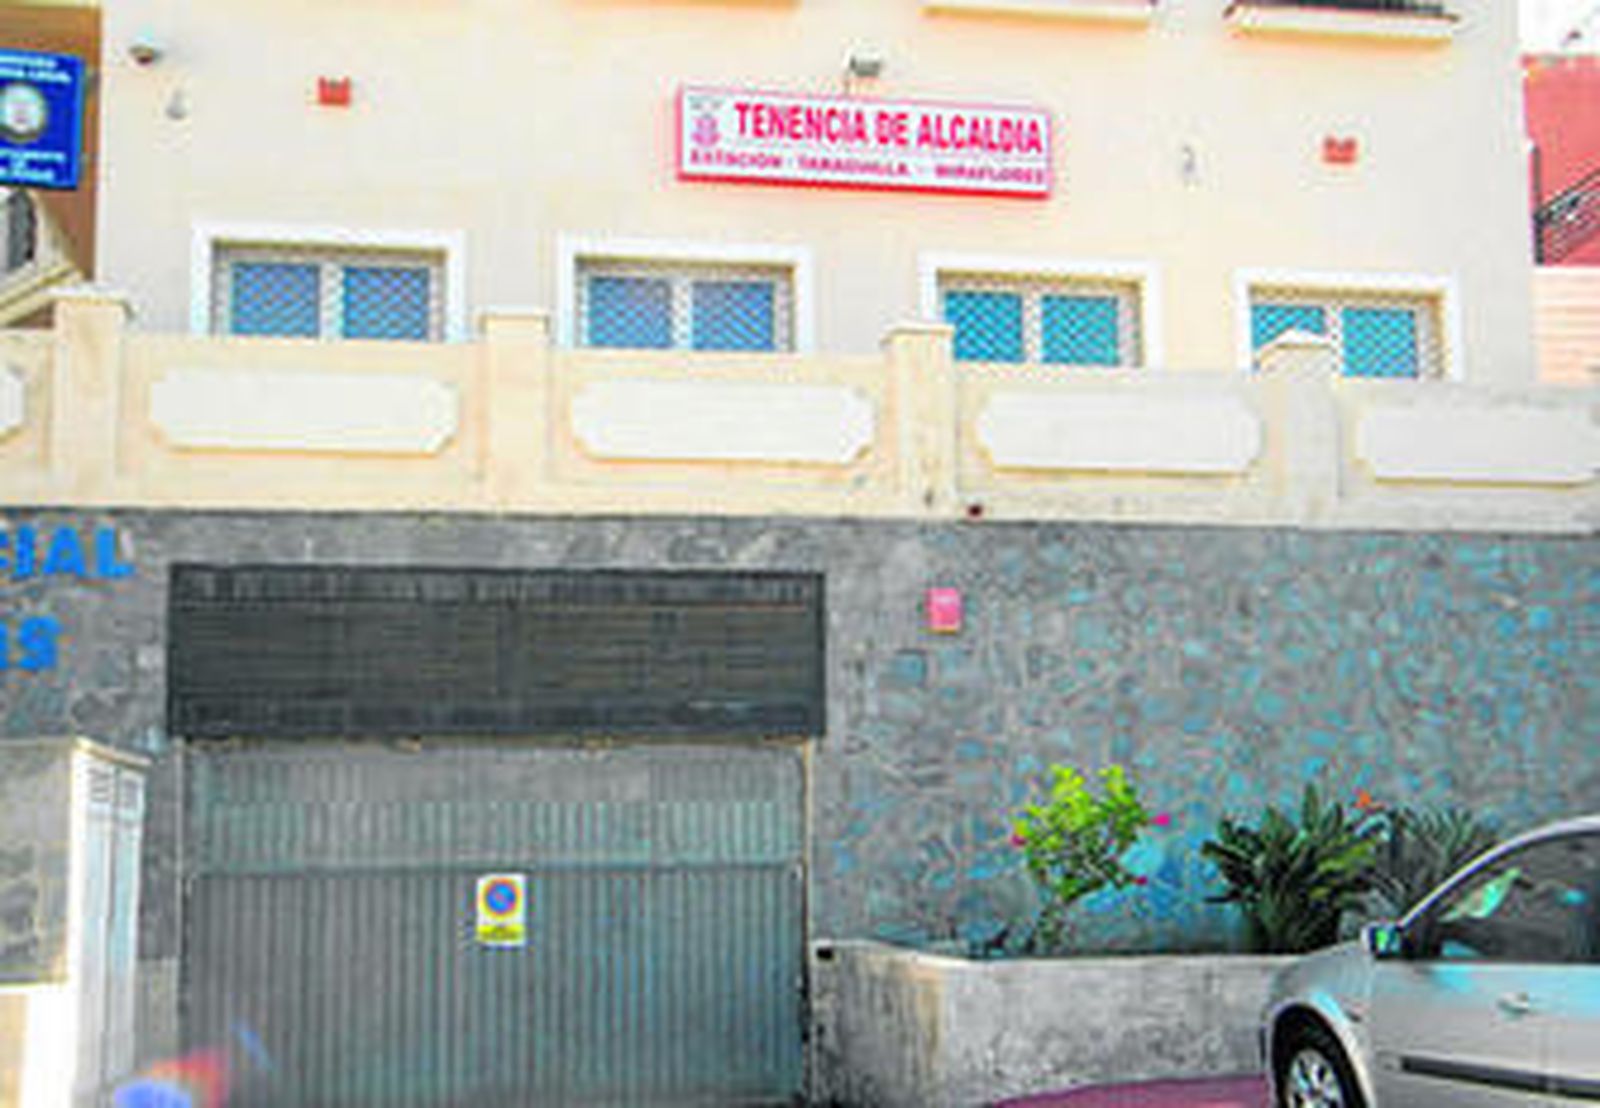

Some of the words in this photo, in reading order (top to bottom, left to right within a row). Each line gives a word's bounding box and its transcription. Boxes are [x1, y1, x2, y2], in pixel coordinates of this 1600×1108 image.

[734, 101, 869, 144] TENENCIA
[874, 110, 909, 146] DE
[916, 113, 1043, 154] ALCALDIA
